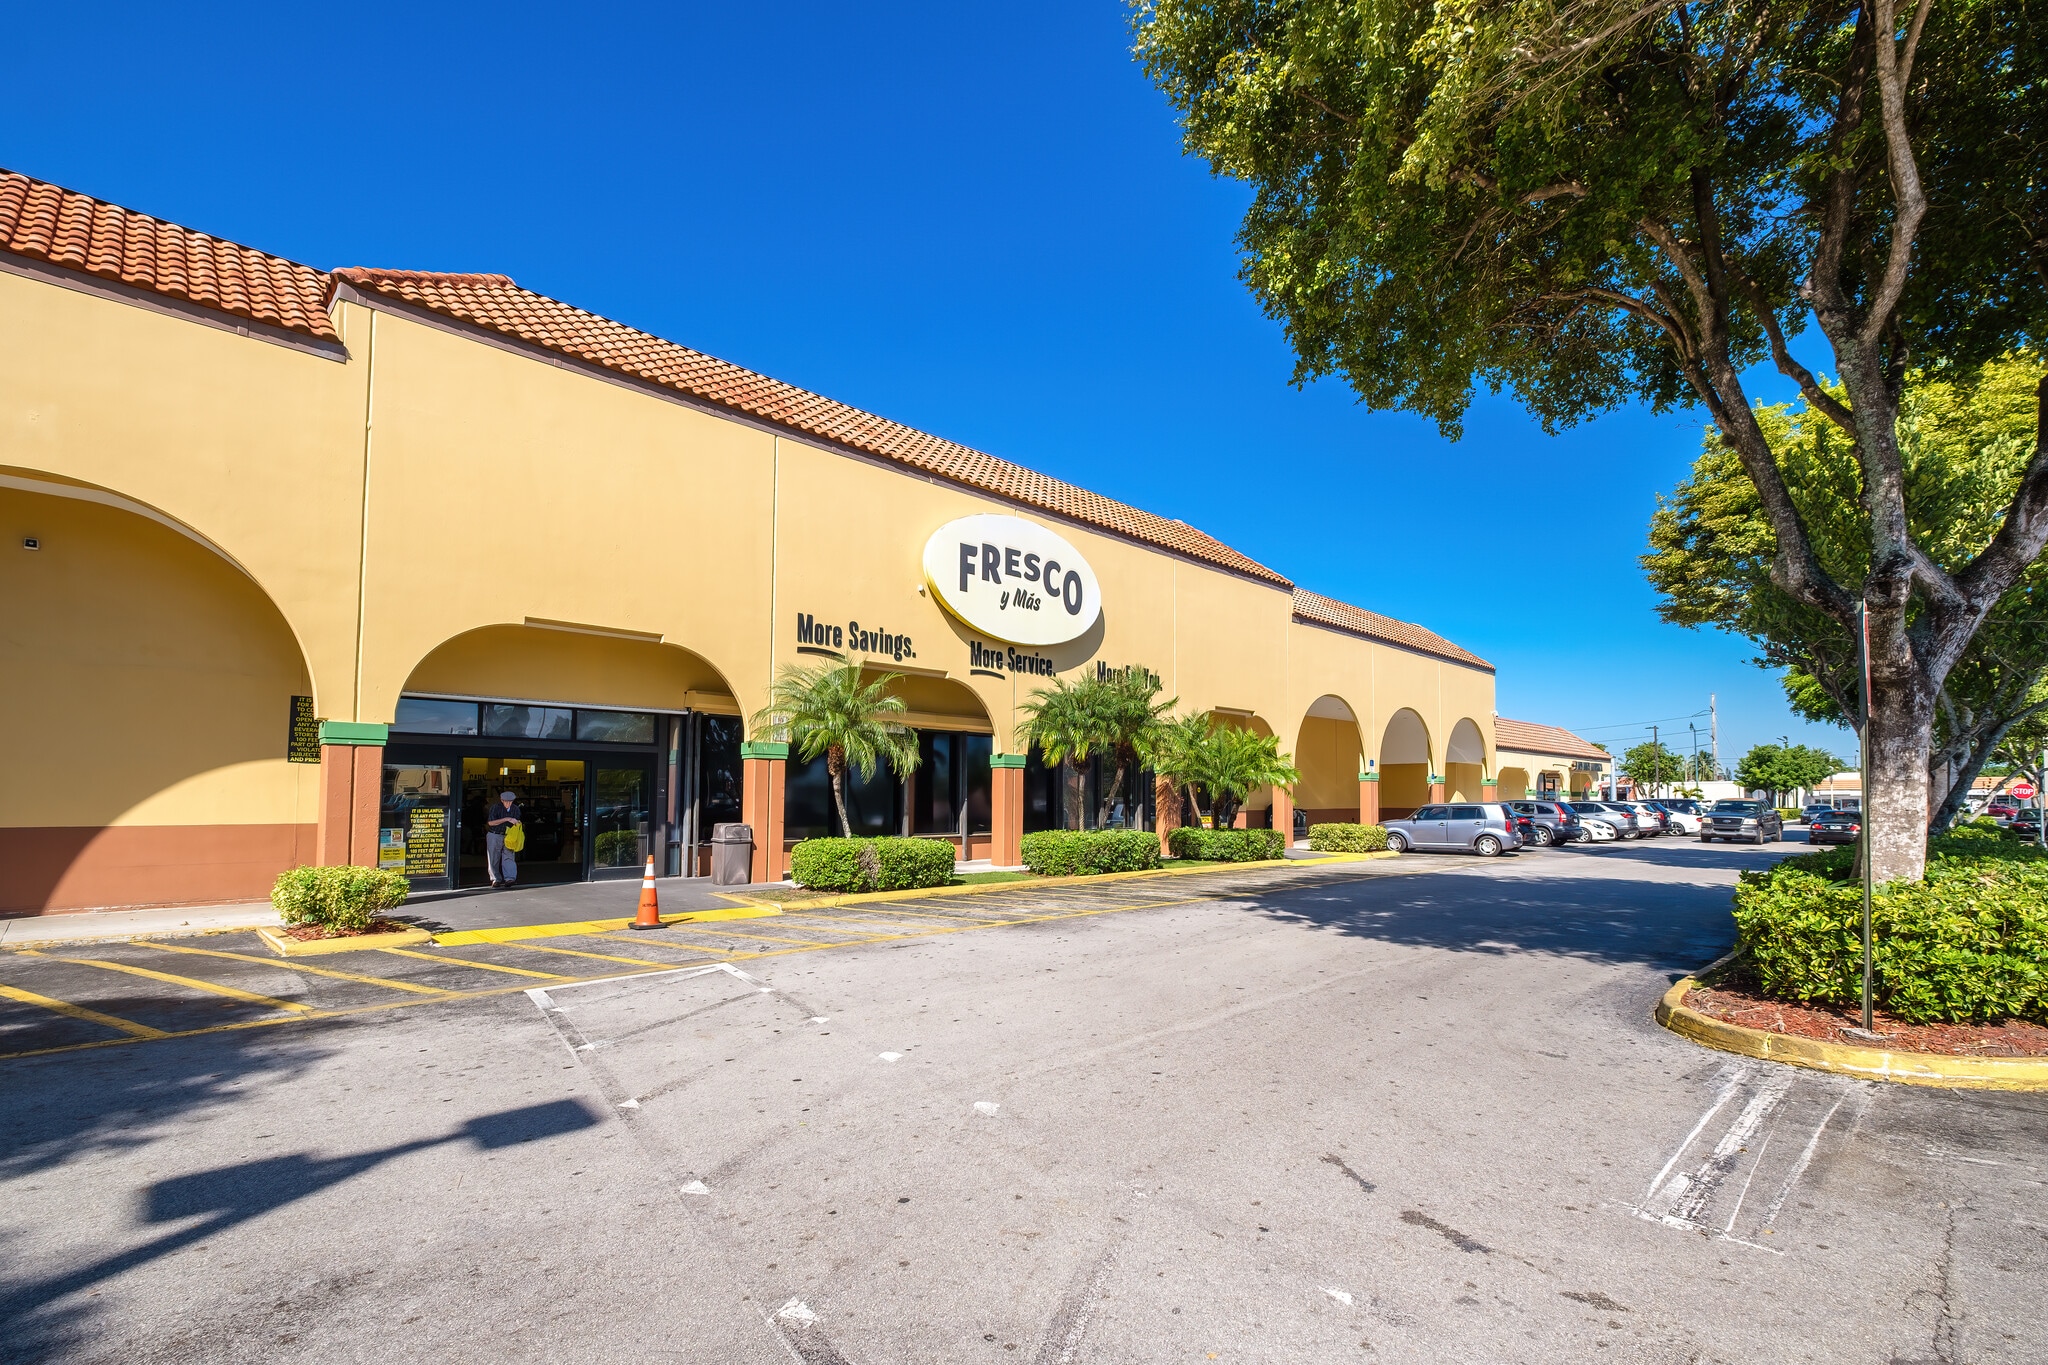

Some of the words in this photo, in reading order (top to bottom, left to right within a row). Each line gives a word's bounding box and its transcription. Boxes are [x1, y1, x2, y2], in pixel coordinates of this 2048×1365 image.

[960, 542, 1083, 616] FRESCO
[1000, 590, 1010, 611] y
[1013, 588, 1042, 611] Más
[797, 613, 842, 648] More
[848, 620, 917, 662] Savings.
[970, 640, 1003, 668] More
[1007, 646, 1056, 678] Service.
[1096, 660, 1122, 684] More
